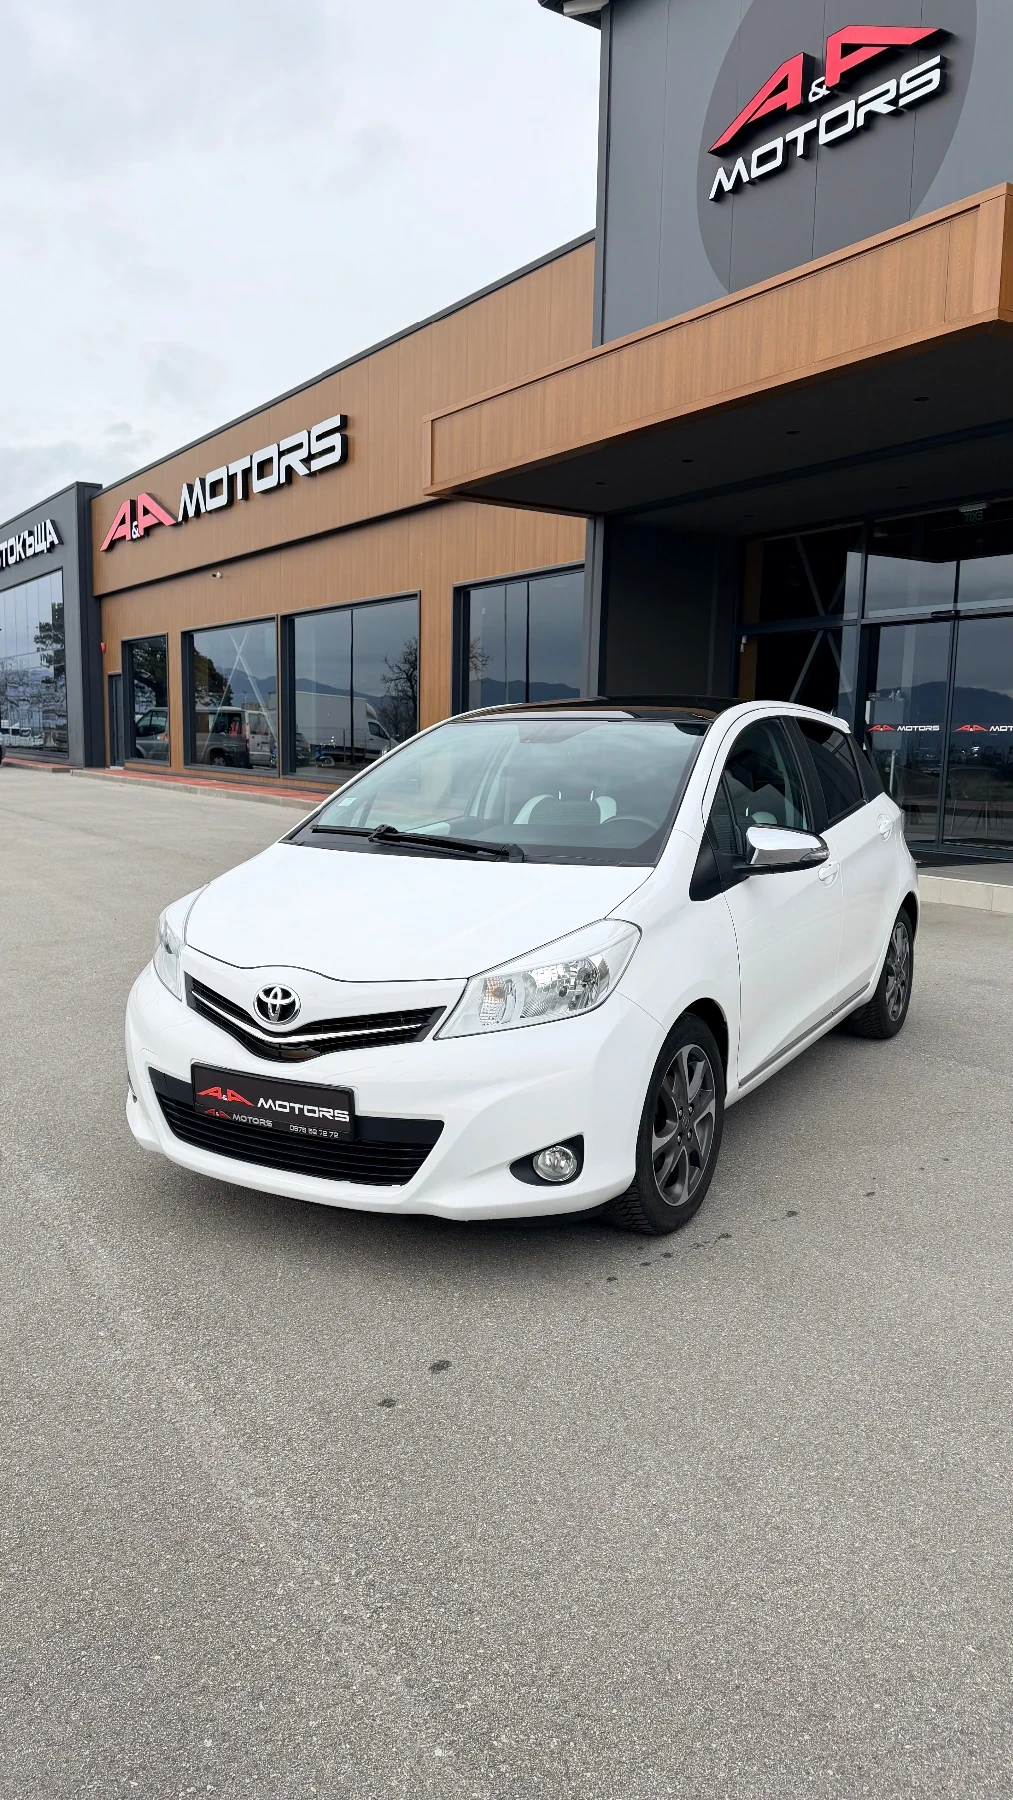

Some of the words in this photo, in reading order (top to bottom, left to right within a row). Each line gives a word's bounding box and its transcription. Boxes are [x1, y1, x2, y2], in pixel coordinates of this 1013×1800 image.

[709, 55, 941, 200] MOTORS
[100, 493, 177, 552] A&A
[178, 414, 342, 522] MOTORS
[0, 519, 59, 568] ТОКЪЩА
[197, 1086, 255, 1107] A&A
[257, 1098, 349, 1122] MOTORS
[232, 1113, 273, 1128] MOTORS
